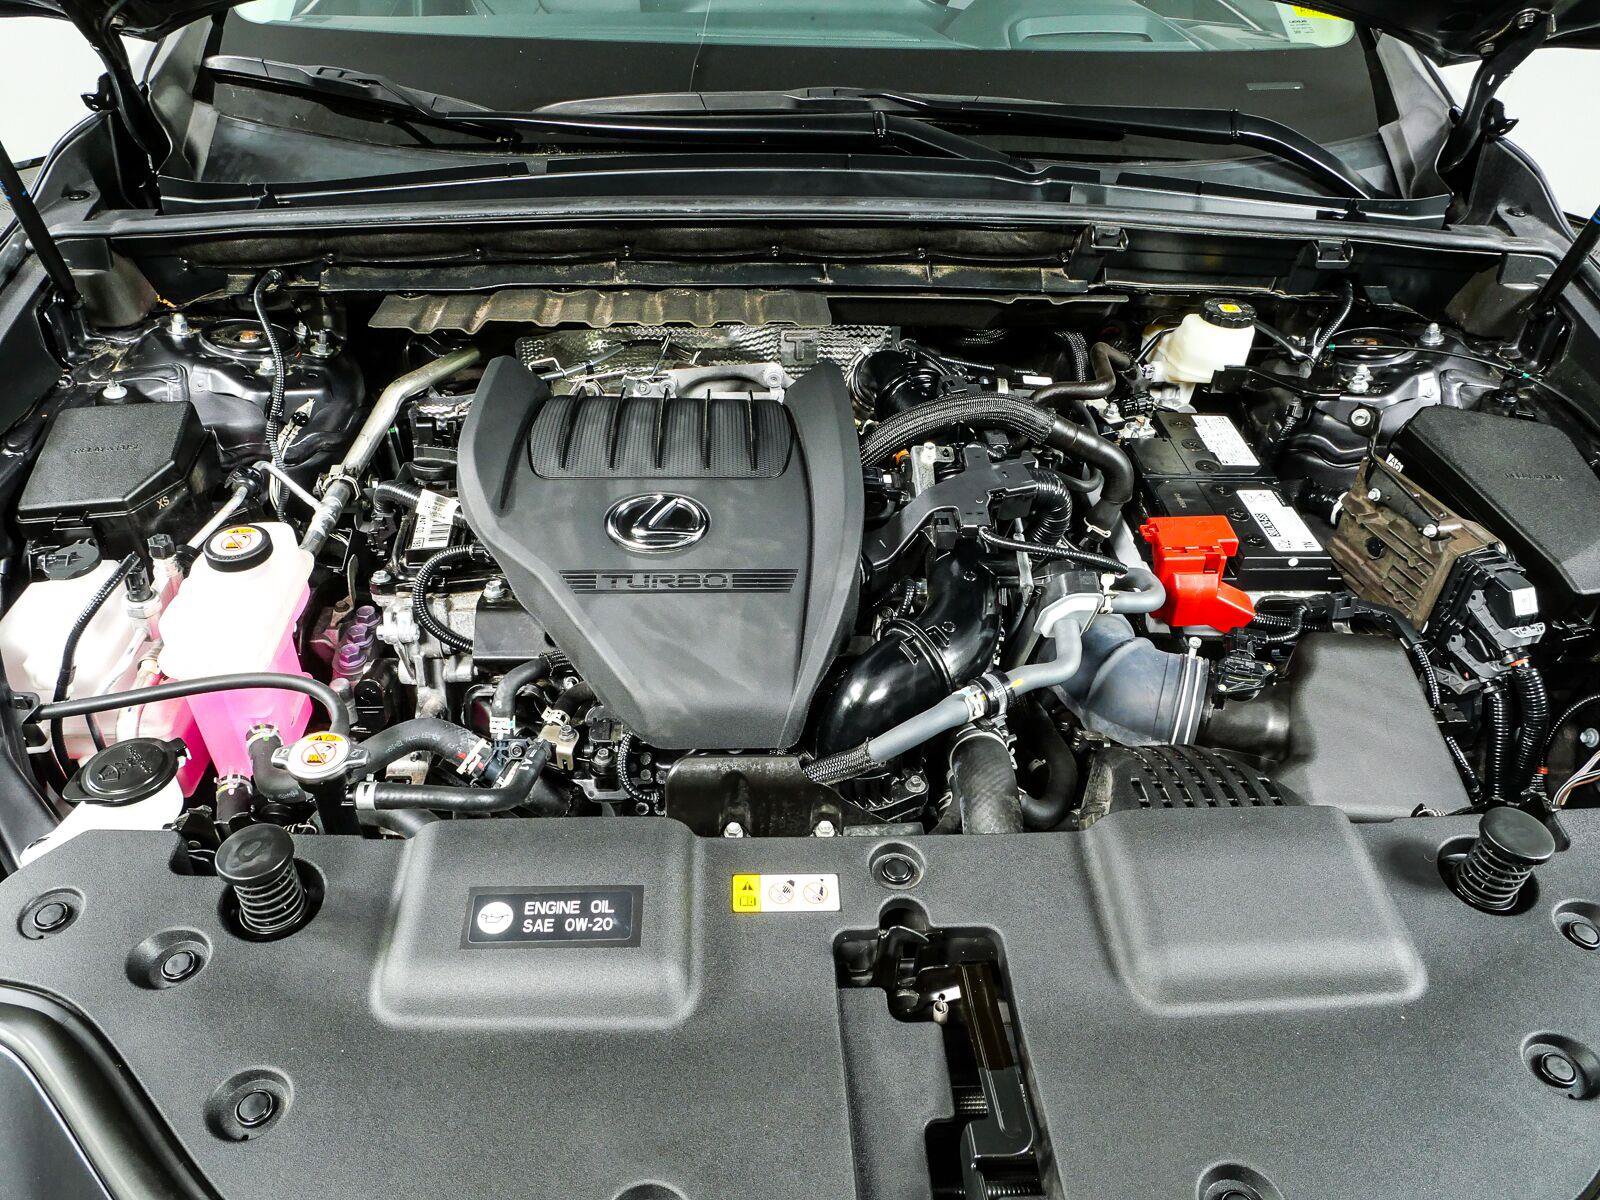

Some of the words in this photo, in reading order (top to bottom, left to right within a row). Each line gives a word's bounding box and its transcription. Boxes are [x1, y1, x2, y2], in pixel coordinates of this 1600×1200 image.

[601, 573, 728, 589] TURBO
[524, 900, 581, 915] ENGINE
[590, 900, 615, 914] OIL
[522, 918, 555, 933] SAE
